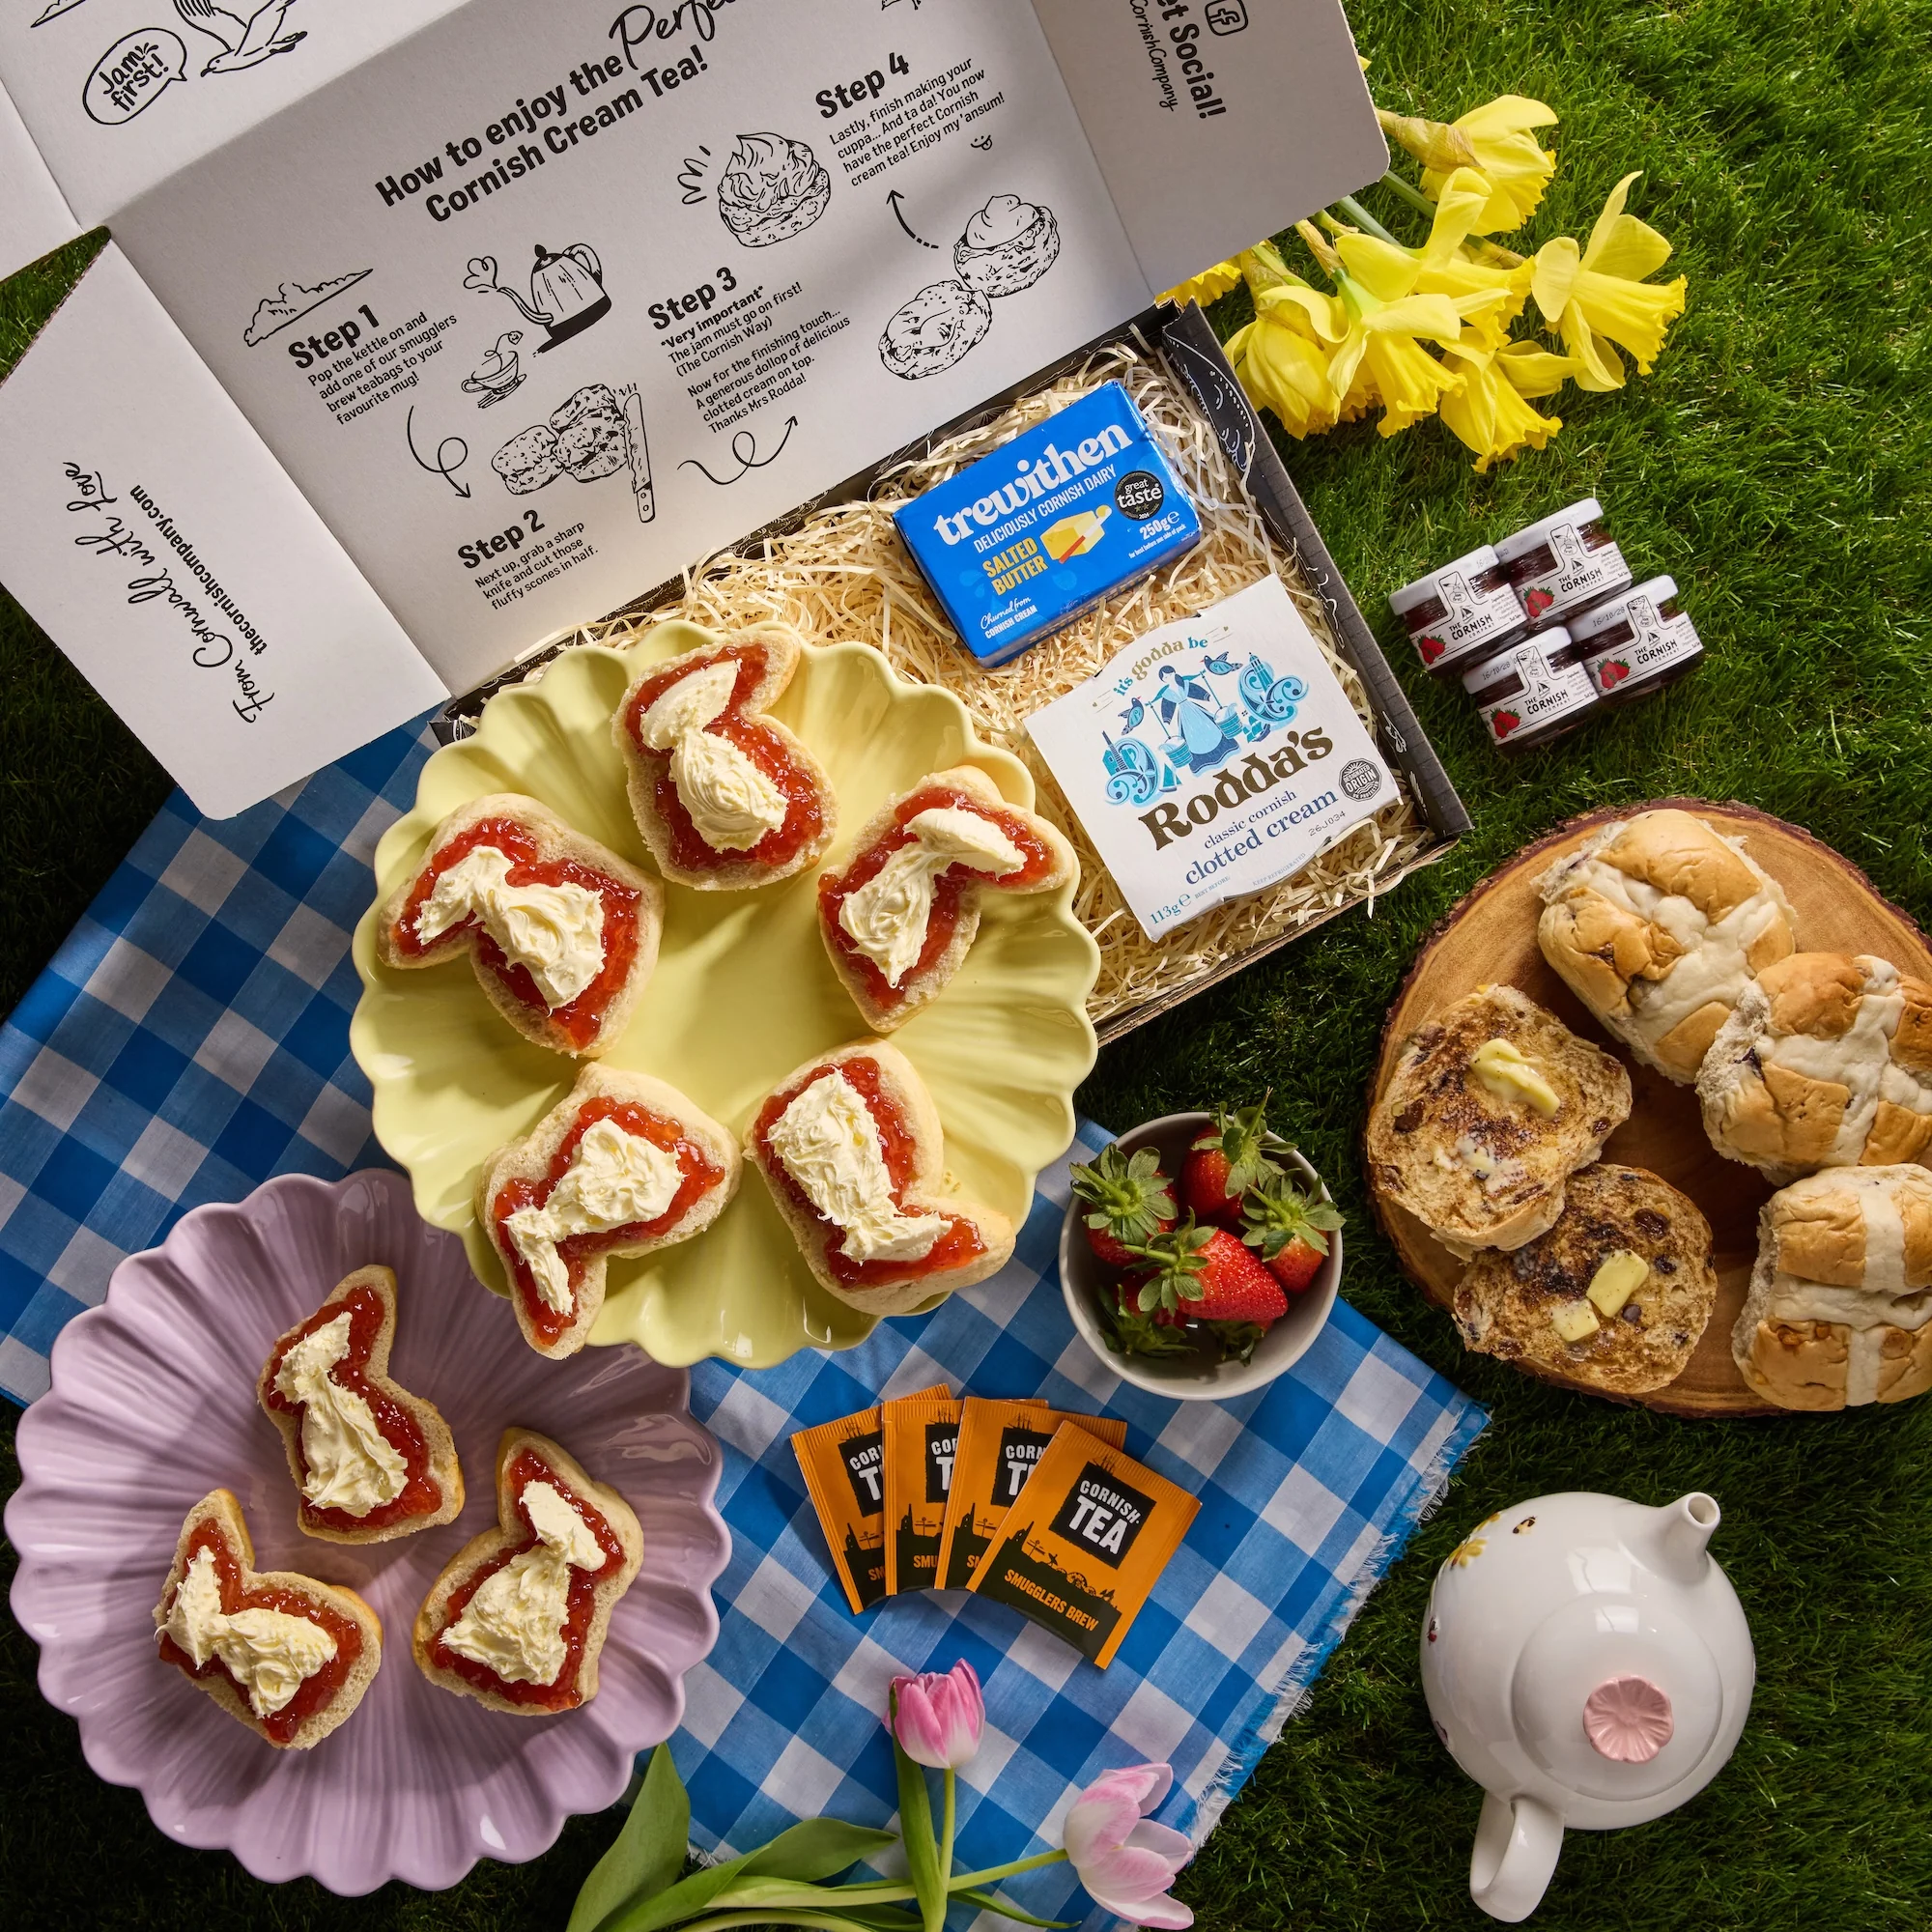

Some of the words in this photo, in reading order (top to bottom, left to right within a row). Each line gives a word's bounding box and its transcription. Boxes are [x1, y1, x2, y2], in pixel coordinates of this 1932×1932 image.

[98, 50, 144, 95] Jam
[110, 52, 168, 111] first!
[816, 71, 884, 117] Step
[890, 52, 908, 73] 4
[830, 120, 868, 144] Lastly,
[870, 99, 902, 121] finish
[904, 74, 946, 102] making
[947, 59, 970, 80] your
[882, 114, 902, 133] And
[904, 108, 917, 119] ta
[920, 95, 936, 111] da!
[937, 84, 959, 99] You
[961, 70, 983, 88] now
[1169, 23, 1227, 119] Social!
[375, 156, 442, 206] How
[445, 137, 481, 165] to
[486, 85, 565, 144] enjoy
[570, 56, 622, 95] the
[426, 145, 544, 220] Cornish
[544, 89, 642, 153] Cream
[640, 44, 706, 96] Tea!
[843, 153, 870, 172] have
[872, 141, 891, 155] the
[894, 115, 934, 146] perfect
[935, 91, 978, 119] Cornish
[852, 162, 885, 185] cream
[887, 146, 909, 164] tea!
[910, 129, 940, 152] Enjoy
[943, 119, 958, 133] my
[648, 284, 715, 328] Step
[717, 268, 735, 290] 3
[668, 349, 689, 362] The
[690, 335, 711, 354] jam
[713, 318, 741, 338] must
[743, 310, 755, 324] go
[758, 301, 772, 312] on
[773, 282, 801, 303] first!
[289, 321, 359, 367] Step
[358, 304, 378, 327] 1
[308, 370, 331, 385] Pop
[332, 357, 353, 371] the
[352, 337, 387, 360] kettle
[389, 327, 404, 339] on
[405, 312, 426, 330] and
[320, 380, 340, 398] add
[342, 370, 362, 384] one
[364, 358, 376, 372] of
[379, 349, 396, 363] our
[399, 316, 456, 352] smugglers
[676, 359, 700, 376] (The
[701, 334, 742, 360] Cornish
[742, 316, 771, 336] Way)
[688, 380, 710, 396] Now
[713, 368, 728, 382] for
[731, 358, 750, 371] the
[752, 330, 799, 359] finishing
[696, 399, 704, 409] A
[706, 372, 753, 405] generous
[755, 353, 786, 375] dollop
[789, 342, 800, 355] of
[803, 318, 849, 347] delicious
[327, 391, 355, 412] brew
[356, 365, 402, 394] teabags
[403, 357, 416, 367] to
[417, 341, 441, 361] your
[337, 391, 389, 423] favourite
[390, 371, 418, 393] mug!
[703, 393, 741, 420] clotted
[743, 376, 776, 397] cream
[778, 367, 790, 378] on
[792, 356, 813, 369] top.
[708, 408, 747, 432] Thanks
[748, 396, 767, 411] Mrs
[768, 373, 805, 399] Rodda!
[62, 462, 117, 511] Love
[933, 424, 1132, 545] trewithen
[973, 508, 1037, 553] DELICIOUSLY
[1037, 482, 1085, 516] CORNISH
[1083, 464, 1116, 491] DAIRY
[1124, 478, 1149, 495] great
[74, 516, 155, 566] with
[458, 526, 523, 567] Step
[524, 510, 544, 531] 2
[475, 569, 500, 586] Next
[502, 562, 519, 572] up,
[520, 545, 544, 564] grab
[554, 523, 583, 542] sharp
[483, 580, 511, 598] knife
[513, 565, 532, 582] and
[534, 555, 552, 569] cut
[553, 539, 582, 558] those
[982, 537, 1037, 577] SALTED
[129, 484, 267, 655] thecornishcompany.com
[492, 588, 523, 609] fluffy
[525, 568, 559, 590] scones
[571, 545, 597, 563] half.
[991, 554, 1048, 595] BUTTER
[1557, 574, 1571, 583] THE
[1560, 567, 1602, 592] CORNISH
[127, 567, 233, 668] Cornwall
[980, 600, 1017, 629] Churned
[1009, 597, 1031, 611] from
[984, 616, 1014, 639] CORNISH
[1013, 604, 1037, 622] CREAM
[1448, 621, 1462, 631] THE
[1451, 613, 1493, 640] CORNISH
[1113, 677, 1132, 696] it's
[1132, 640, 1183, 679] godda
[1187, 637, 1207, 648] be
[1634, 645, 1647, 655] THE
[1636, 639, 1677, 664] CORNISH
[232, 659, 274, 723] From
[1523, 696, 1537, 705] THE
[1526, 689, 1569, 715] CORNISH
[1137, 725, 1333, 851] Rodda's
[1185, 828, 1263, 884] clotted
[1266, 790, 1339, 837] cream
[1204, 820, 1246, 848] classic
[1248, 790, 1296, 823] cornish
[1068, 1494, 1127, 1554] TEA
[1004, 1569, 1066, 1612] SMUGGLERS
[1065, 1605, 1098, 1631] BREW
